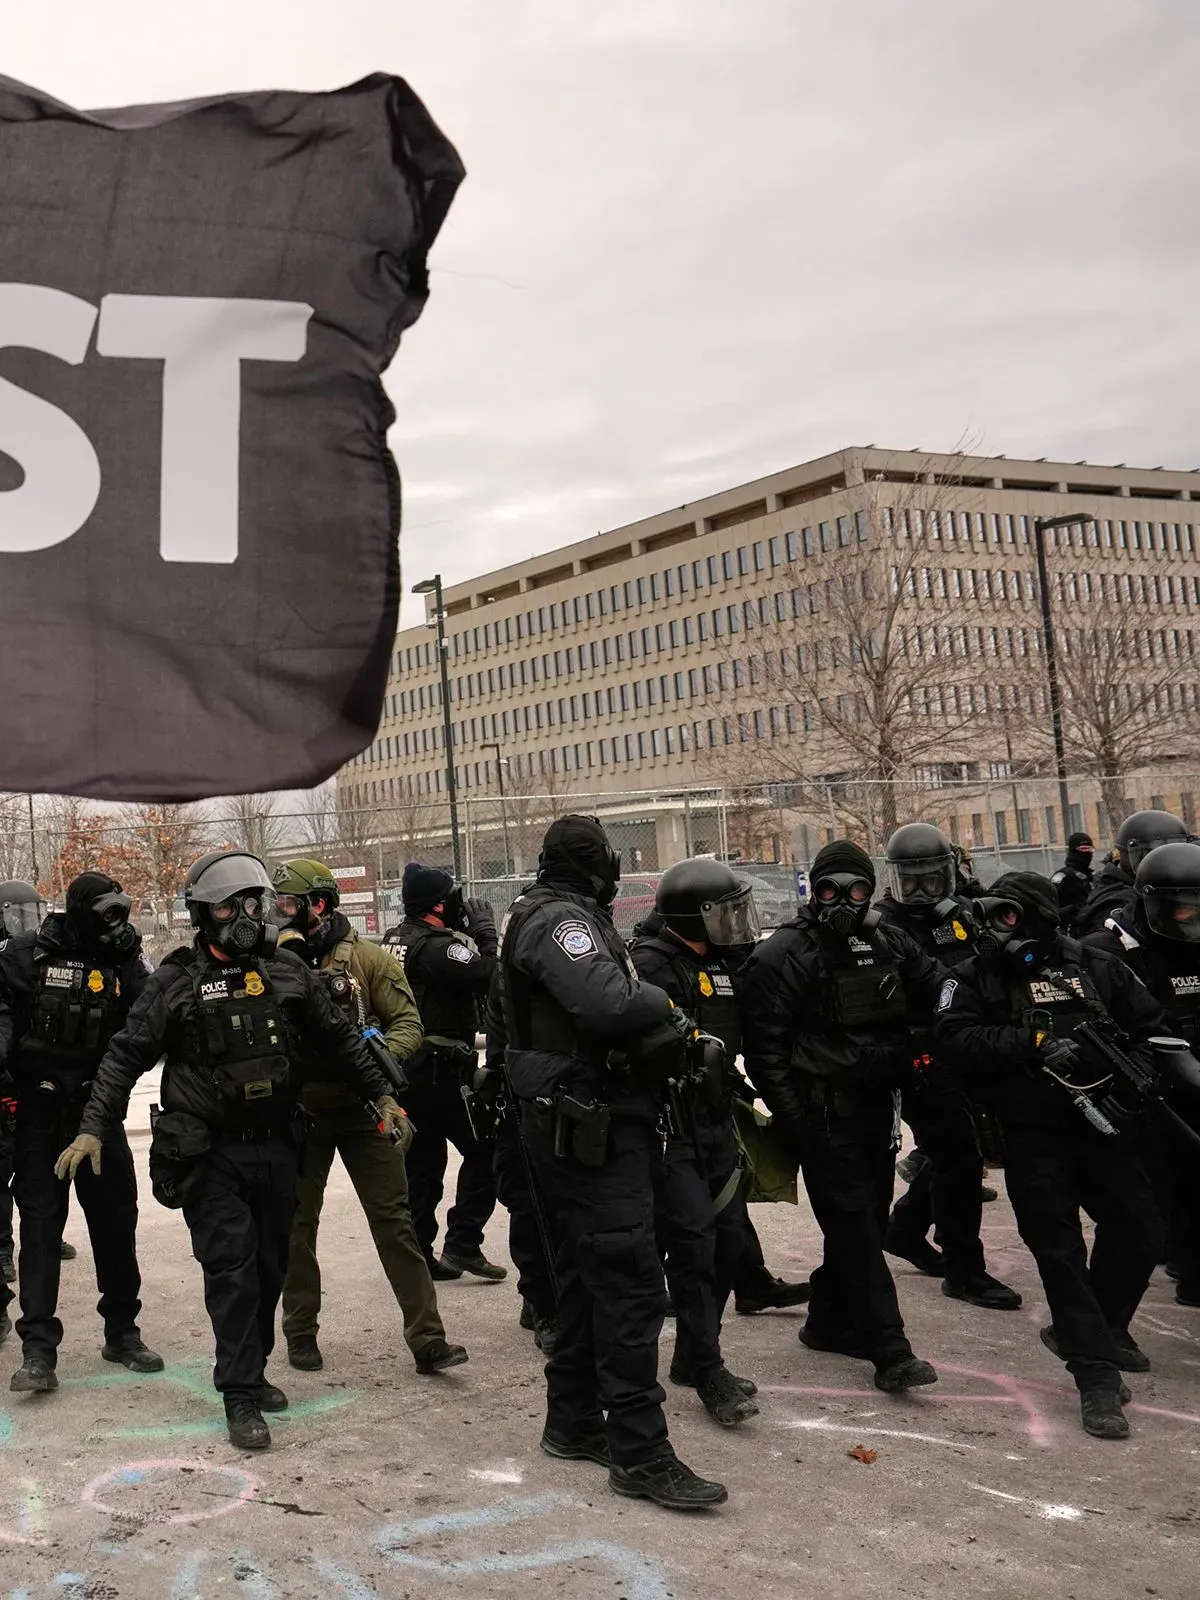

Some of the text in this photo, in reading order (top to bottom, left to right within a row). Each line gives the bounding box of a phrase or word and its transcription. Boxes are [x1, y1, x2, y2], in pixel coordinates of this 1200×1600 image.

[47, 967, 74, 980] POLICE
[201, 980, 227, 994] POLICE
[1030, 978, 1081, 993] POLE
[1171, 975, 1200, 987] POLICE
